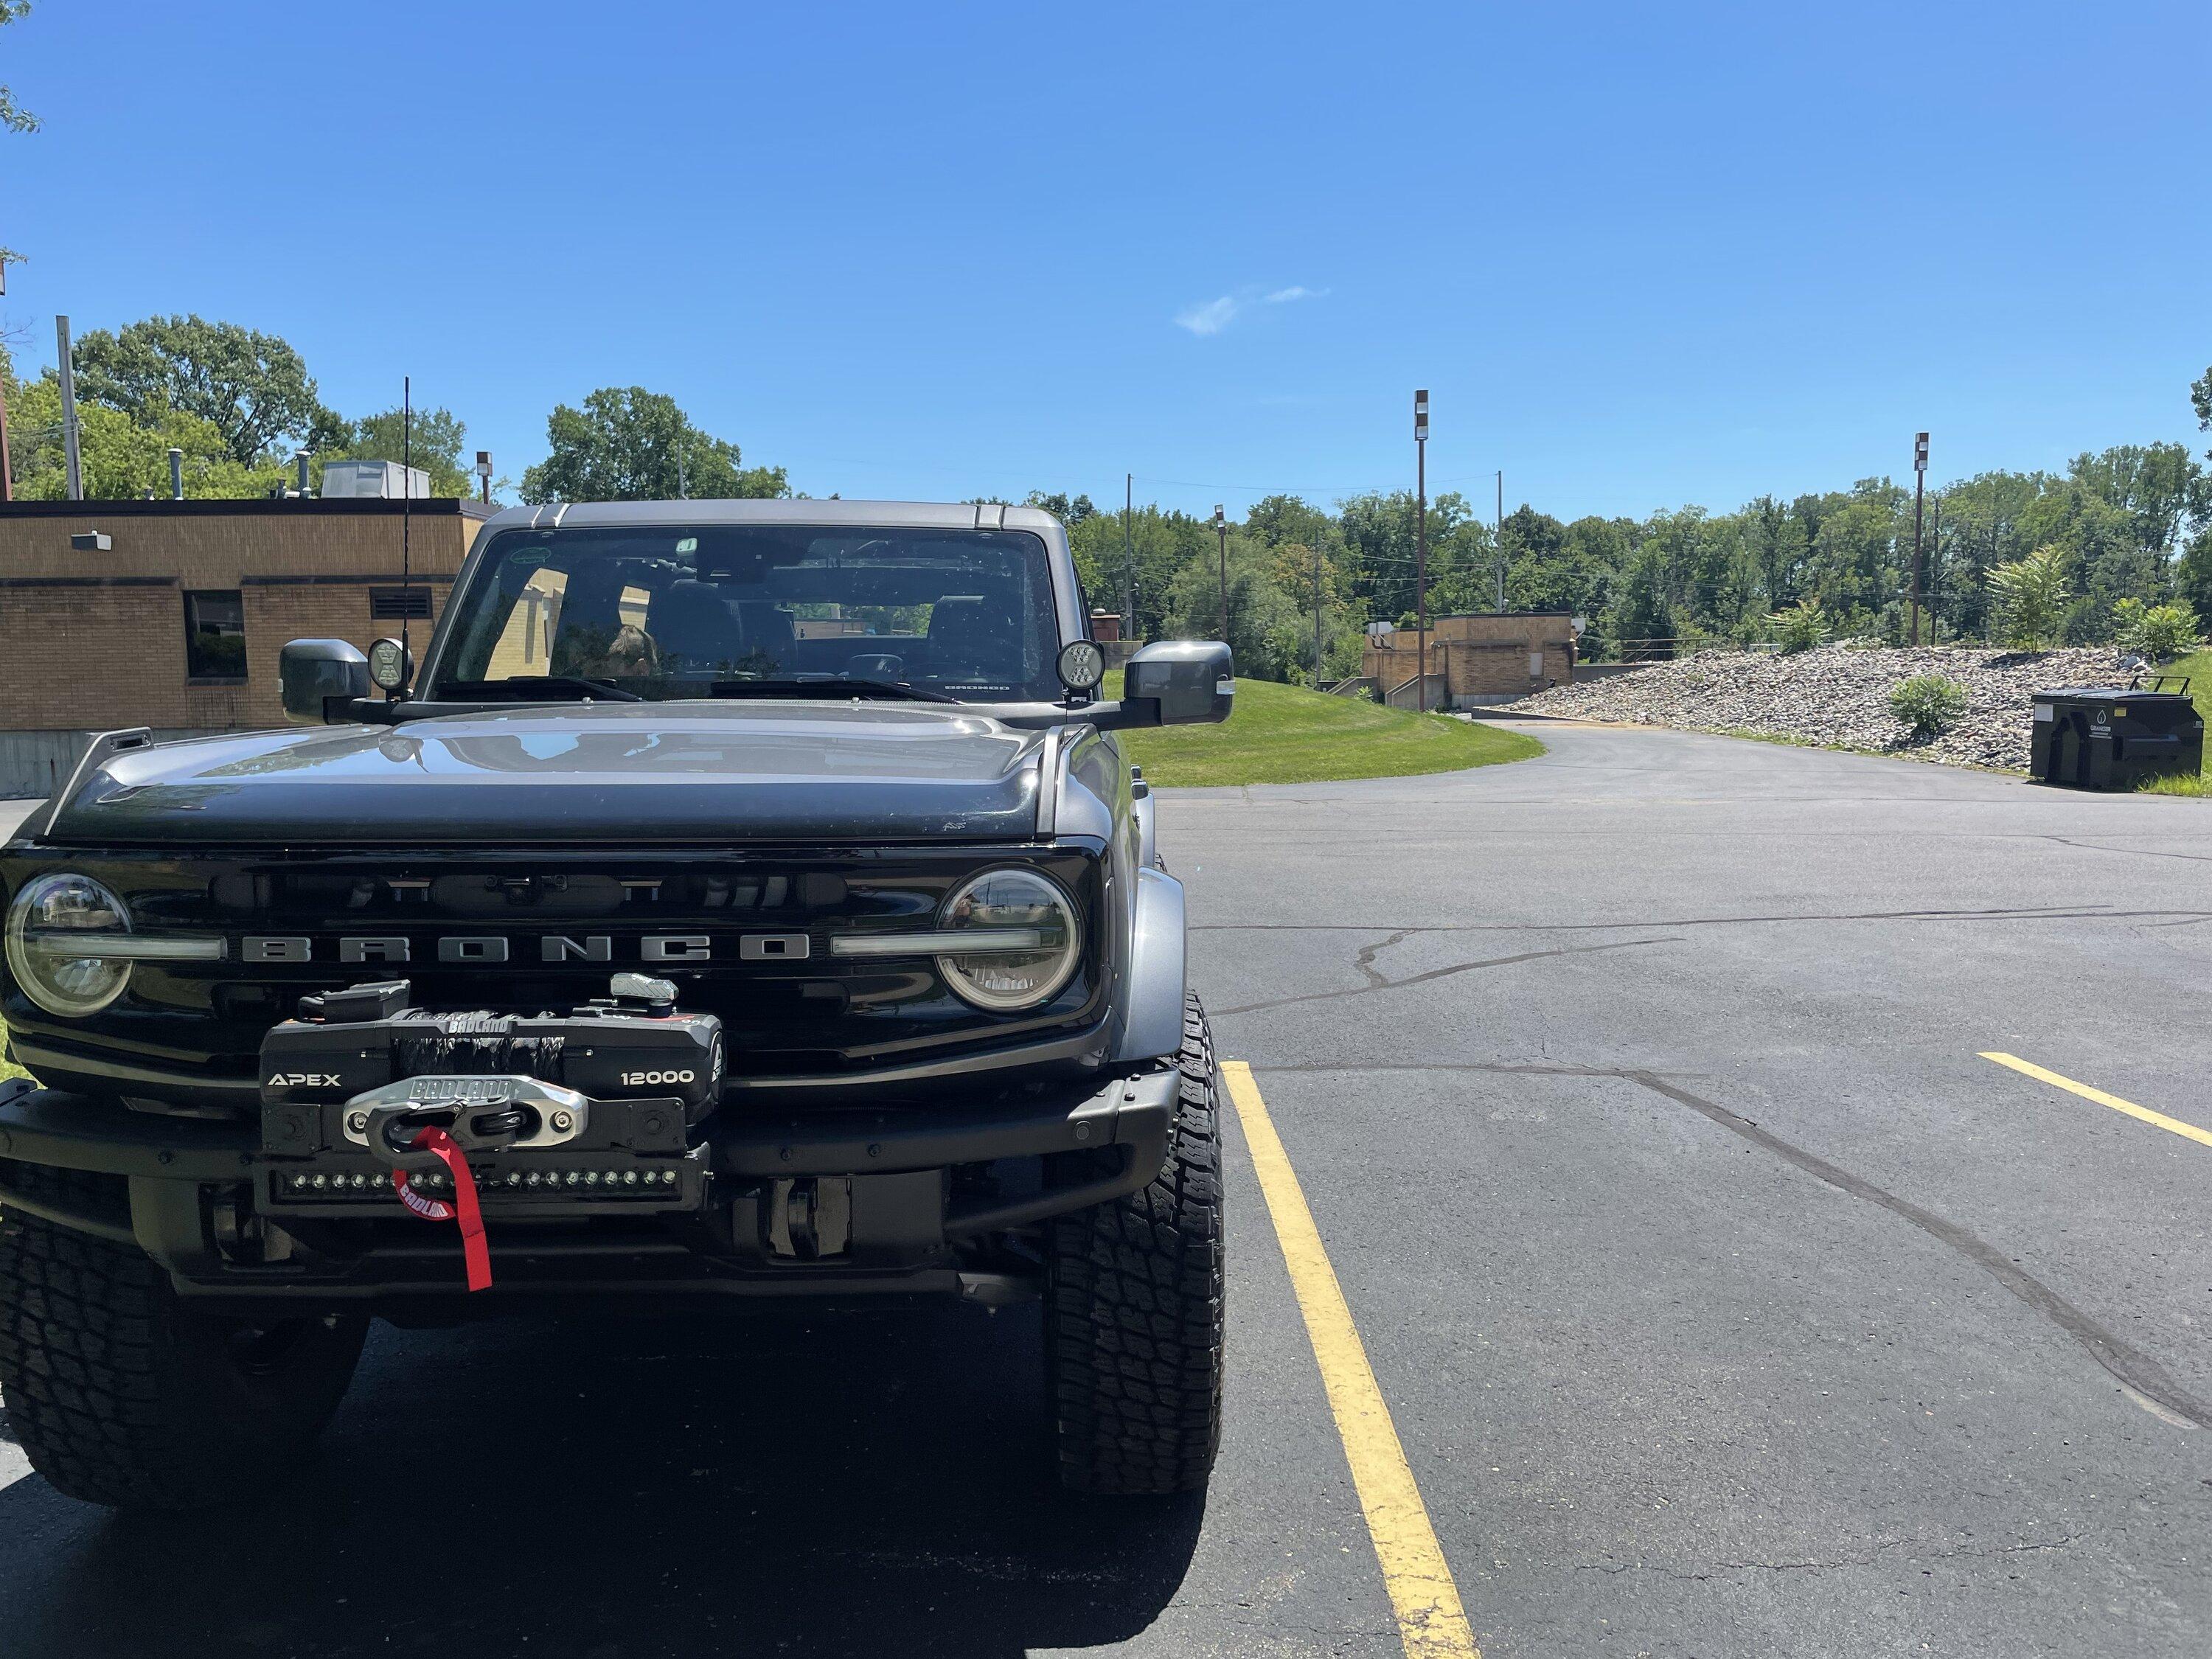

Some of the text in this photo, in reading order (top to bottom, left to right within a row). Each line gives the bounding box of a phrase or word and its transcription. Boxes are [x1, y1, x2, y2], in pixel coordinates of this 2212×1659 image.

[243, 933, 810, 961] BRONCO
[448, 1020, 509, 1034] BADLAND
[268, 1074, 341, 1087] APEX
[620, 1070, 695, 1085] 12000
[408, 1079, 513, 1099] BADLAND
[400, 1183, 448, 1217] BADLAND
